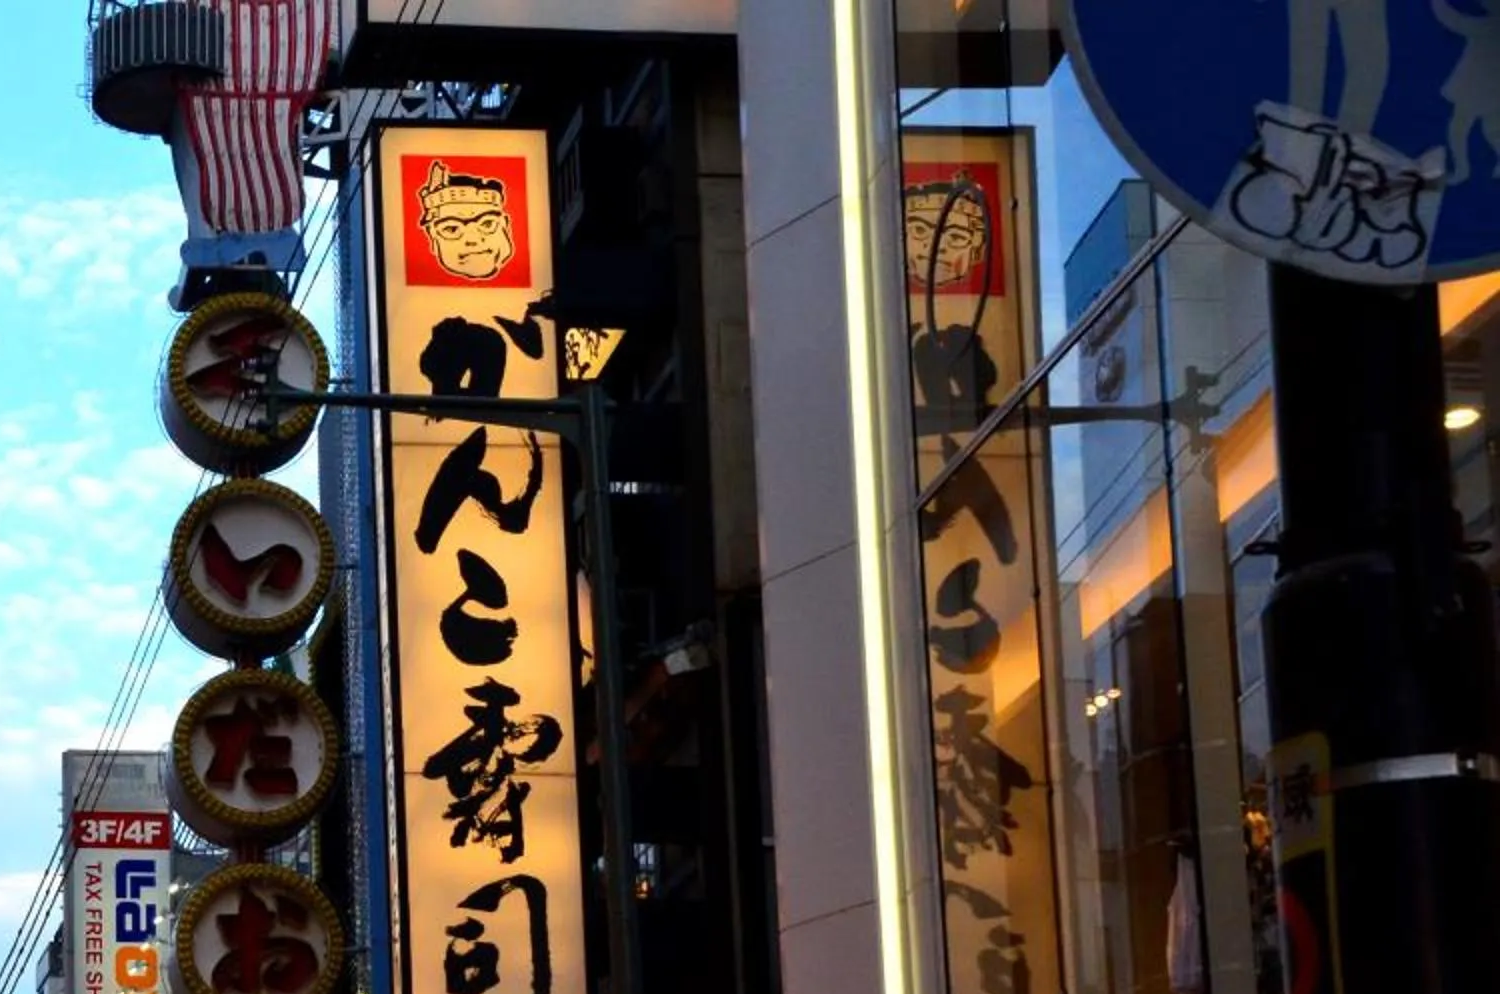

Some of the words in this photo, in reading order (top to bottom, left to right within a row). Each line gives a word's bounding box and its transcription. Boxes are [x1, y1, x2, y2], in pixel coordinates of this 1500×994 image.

[81, 819, 162, 842] 3F/4F
[84, 862, 102, 902] TAX
[85, 908, 103, 966] FREE
